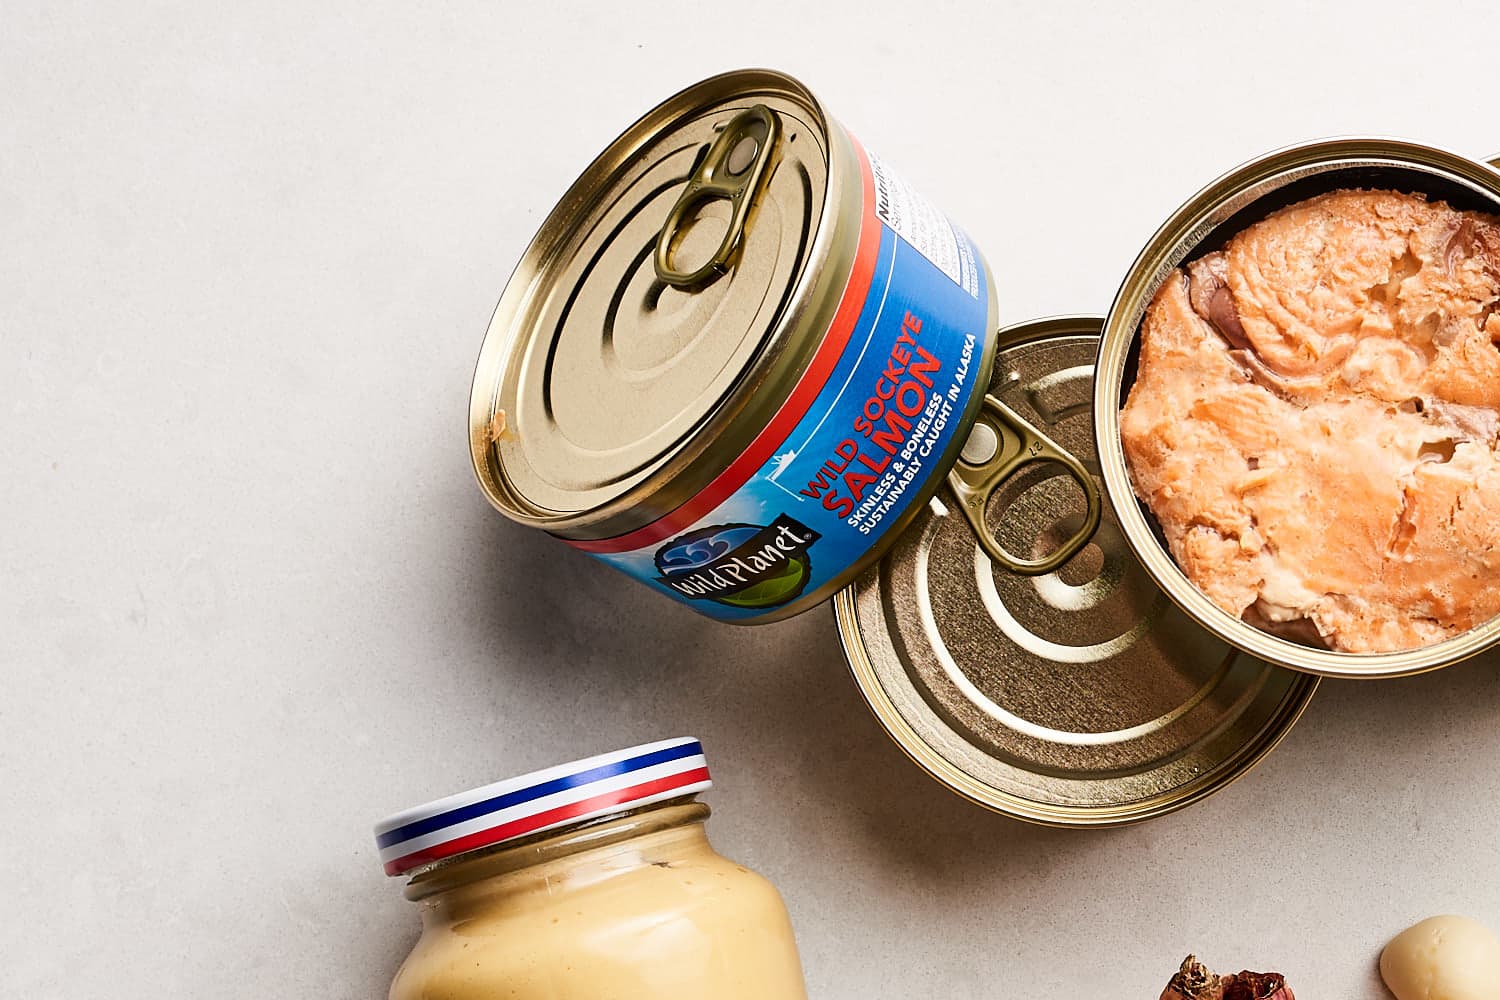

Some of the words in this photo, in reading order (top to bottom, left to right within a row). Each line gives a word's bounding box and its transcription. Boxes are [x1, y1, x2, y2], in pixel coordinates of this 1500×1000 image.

[800, 438, 858, 499] WILD
[854, 311, 923, 437] SOCKEYE
[822, 346, 942, 518] SALMON
[847, 472, 896, 528] SKINLESS
[893, 462, 905, 473] &
[901, 392, 943, 460] BONELESS
[859, 457, 922, 535] SUSTAINABLY
[919, 400, 954, 458] CAUGHT
[947, 384, 961, 402] IN
[954, 333, 976, 386] ALASKA
[672, 568, 736, 596] Wild
[716, 525, 805, 582] Planet
